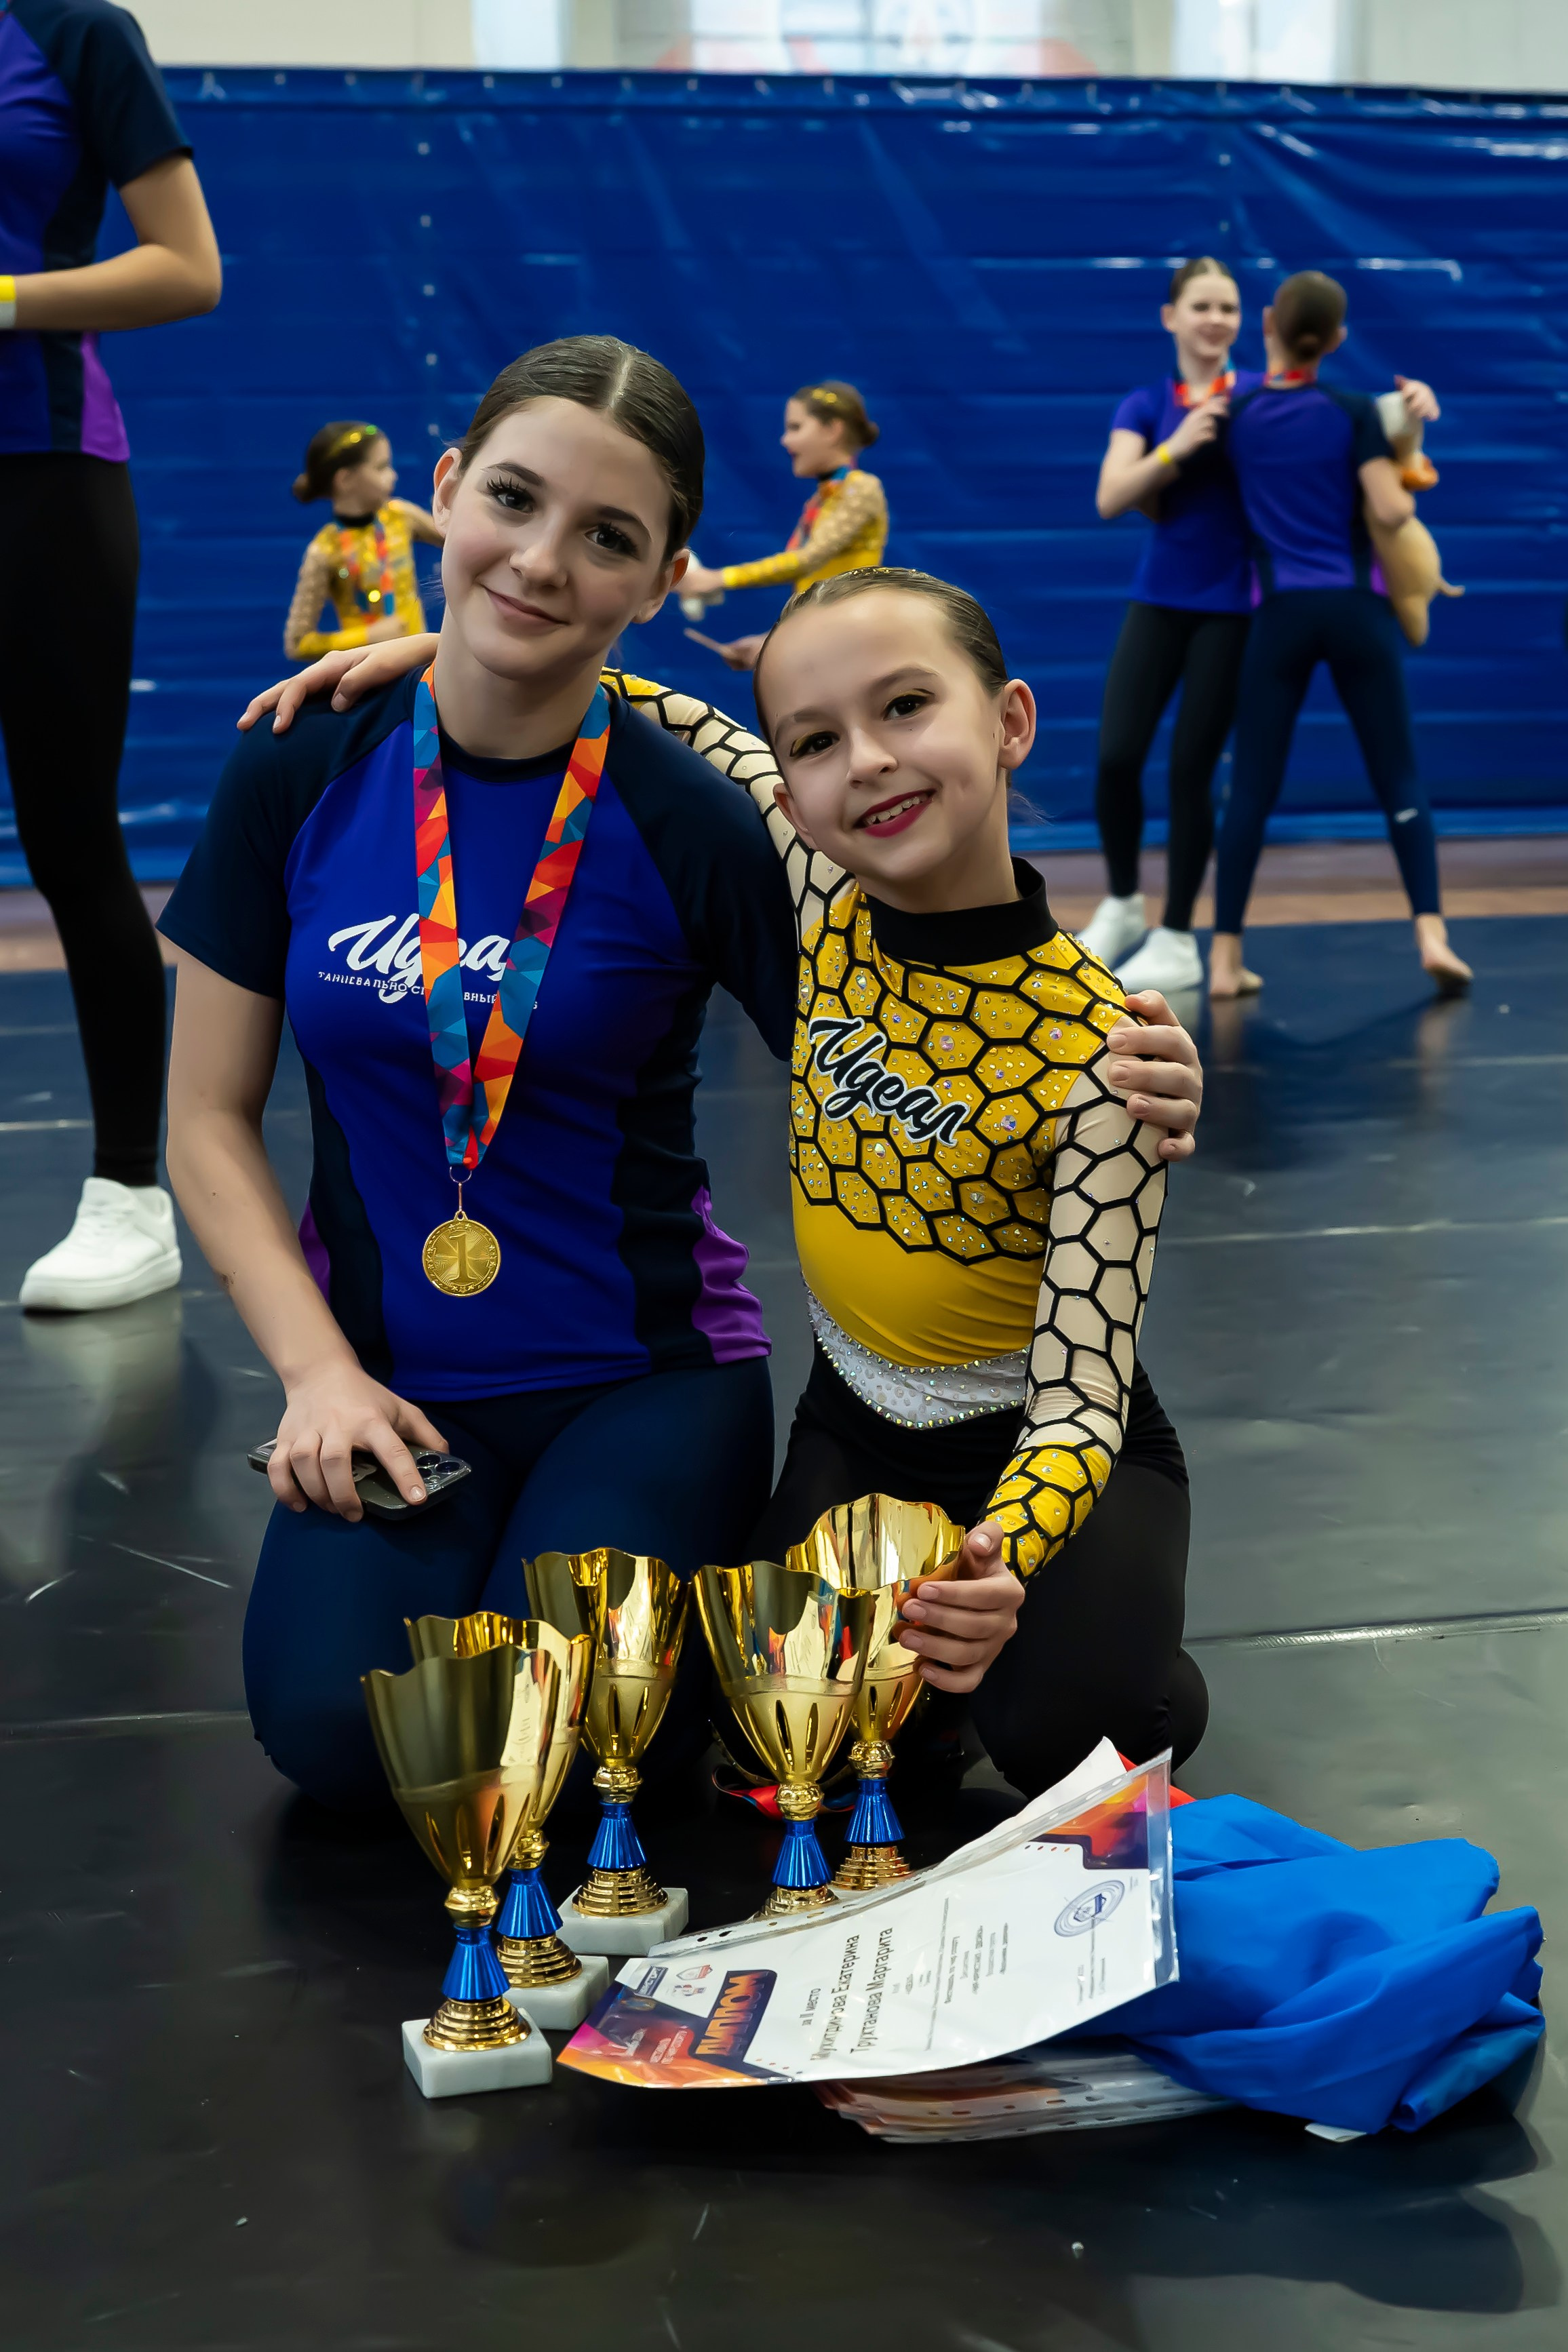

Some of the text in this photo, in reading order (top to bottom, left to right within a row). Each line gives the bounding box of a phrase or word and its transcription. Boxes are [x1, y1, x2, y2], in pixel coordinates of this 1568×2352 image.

[808, 1017, 971, 1148] Идеал
[448, 1229, 478, 1286] 1
[831, 1935, 861, 1994] Екатерина
[850, 1927, 895, 2054] Трухтанова Маргарита
[694, 1970, 769, 2057] ДИПЛОМ
